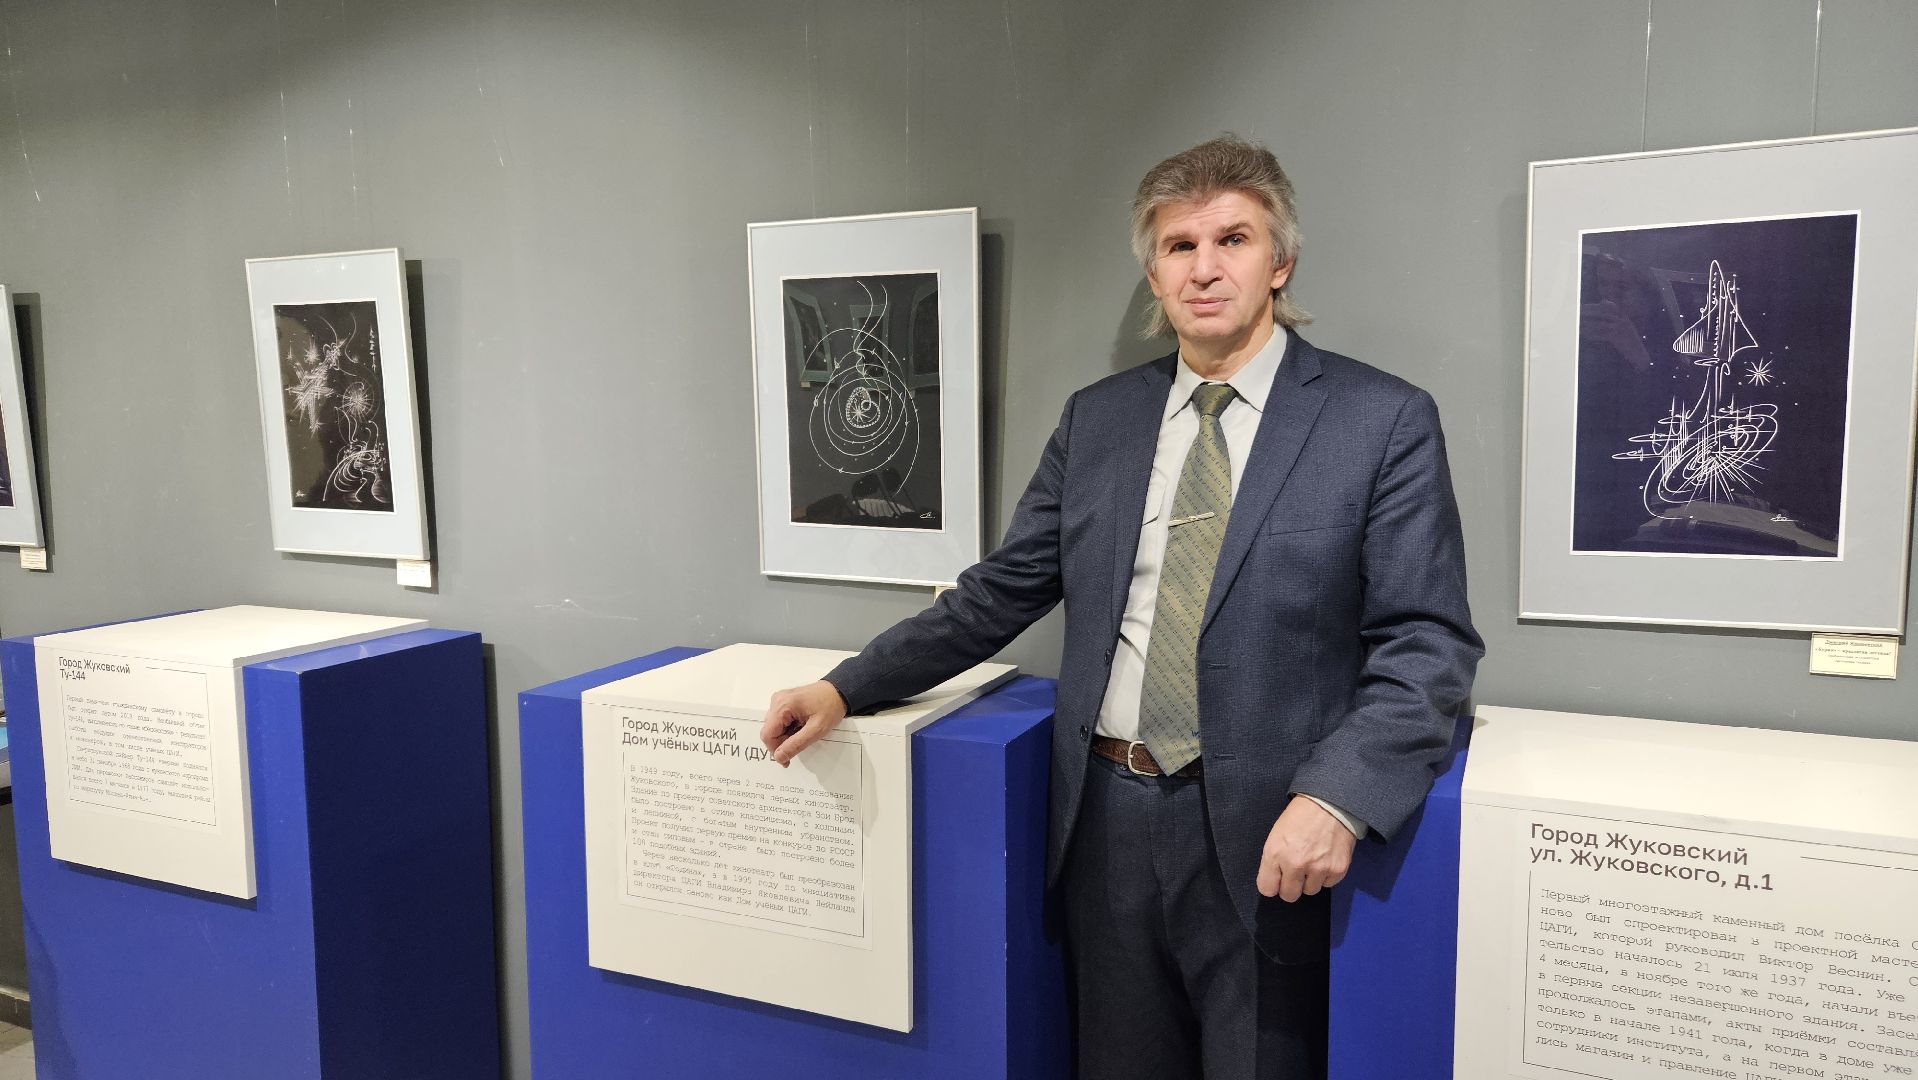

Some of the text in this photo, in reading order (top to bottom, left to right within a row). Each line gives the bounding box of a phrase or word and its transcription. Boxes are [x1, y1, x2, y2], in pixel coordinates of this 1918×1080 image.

[59, 657, 131, 674] Город Жуковский
[59, 669, 86, 681] Ту-144
[622, 717, 737, 740] Город Жуковский
[622, 732, 648, 746] Дом
[652, 738, 699, 752] учёных
[703, 741, 740, 757] ЦАГИ
[1530, 845, 1774, 891] ул. Жуковского, д.1
[1531, 823, 1748, 866] Город Жуковский
[1541, 907, 1572, 918] ново
[1624, 919, 1736, 942] спроектирован
[1750, 936, 1760, 945] в
[1775, 940, 1858, 959] проектной
[1599, 899, 1703, 920] многоэтажный
[1713, 914, 1784, 931] каменный
[1795, 926, 1824, 937] дом
[1834, 931, 1900, 947] посёлка
[1614, 951, 1683, 968] началось
[1693, 960, 1712, 973] 21
[1723, 967, 1758, 979] июля
[1771, 972, 1806, 987] 1937
[1818, 982, 1862, 995] года.
[1877, 988, 1905, 1002] Уже
[1665, 942, 1744, 960] руководил
[1759, 953, 1813, 972] Виктор
[1828, 963, 1891, 982] Веснин.
[1537, 972, 1546, 980] в
[1612, 984, 1661, 999] секции
[1802, 1014, 1864, 1031] здания.
[1538, 953, 1918, 1022] 4 месяца, в ноябре того же года, начали въе
[1537, 989, 1635, 1011] продолжалось
[1647, 1006, 1712, 1025] этапами,
[1726, 1019, 1761, 1032] акты
[1772, 1027, 1836, 1044] приёмки
[1537, 1005, 1912, 1074] только в начале 1941 года, когда в доме уже
[1536, 1037, 1736, 1079] лись магазин и правление
[1537, 1021, 1618, 1041] сотрудники
[1722, 1052, 1731, 1061] а
[1741, 1055, 1759, 1066] на
[1769, 1060, 1824, 1077] первом
